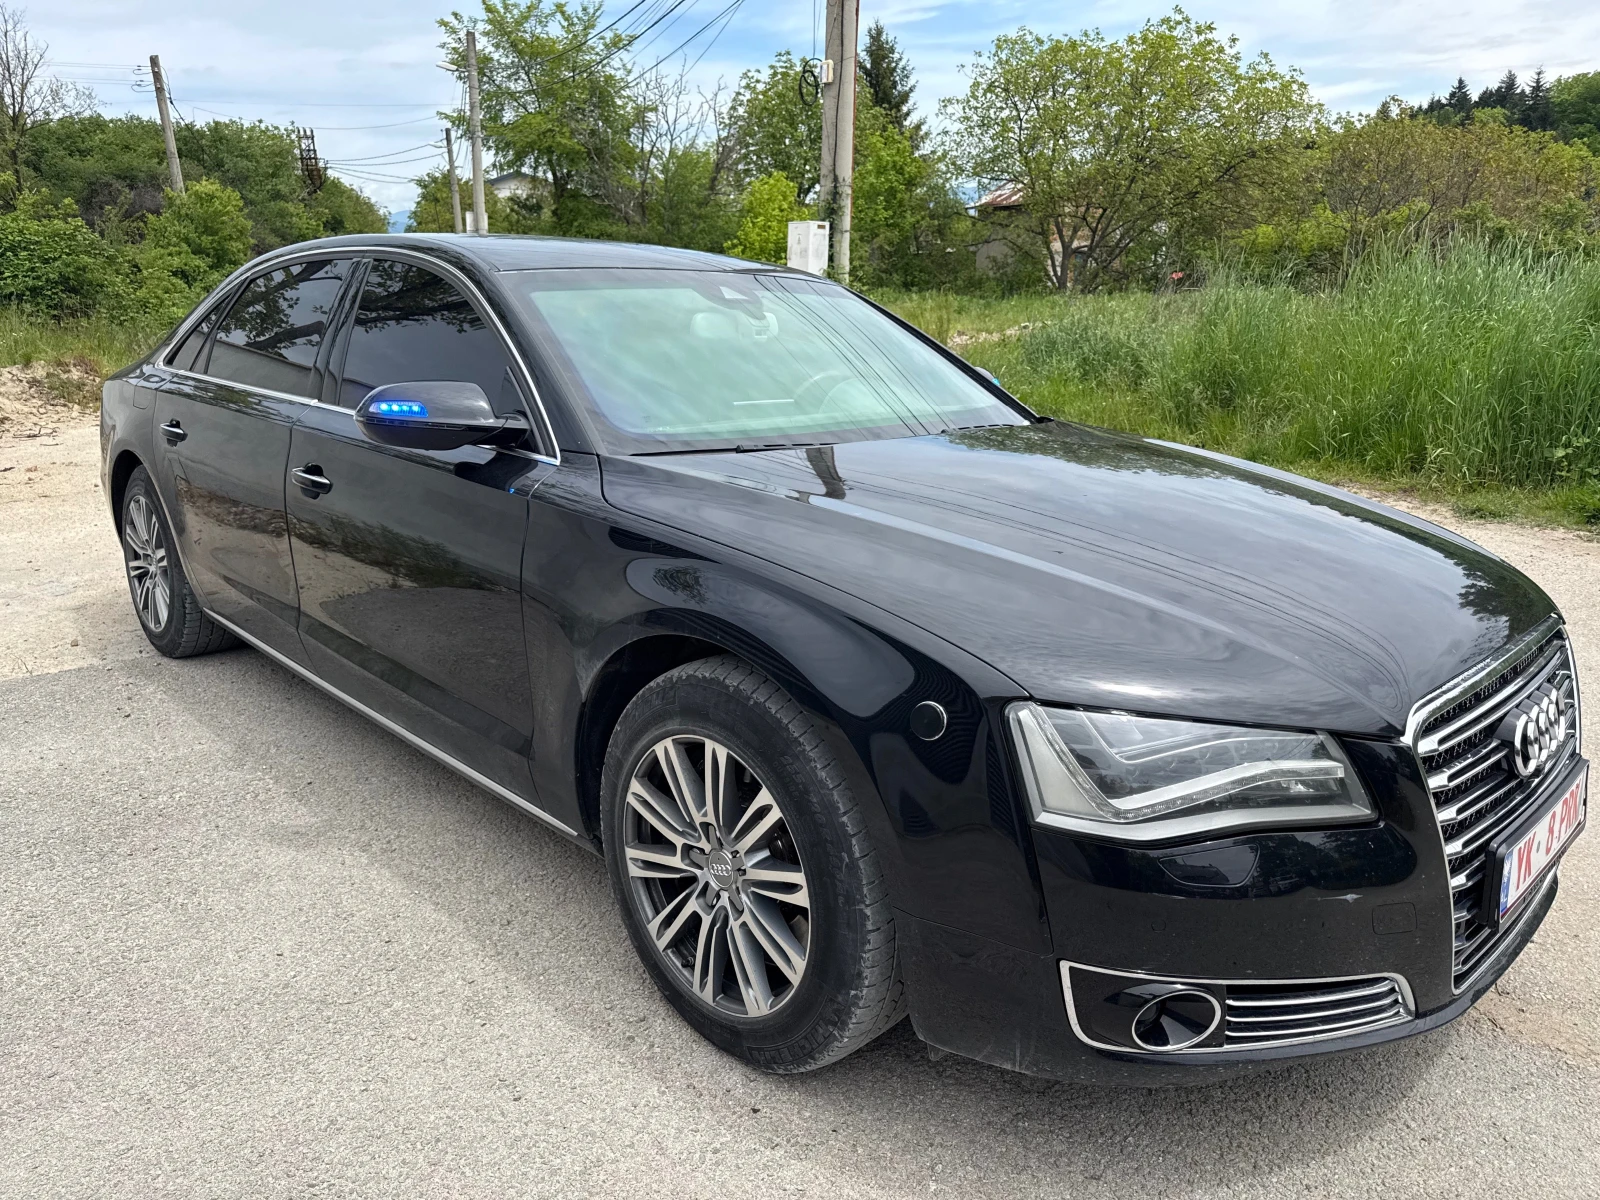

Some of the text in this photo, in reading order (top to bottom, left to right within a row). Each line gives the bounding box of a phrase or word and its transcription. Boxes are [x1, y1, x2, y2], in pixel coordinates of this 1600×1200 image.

[1516, 831, 1536, 891] YK
[1545, 810, 1556, 855] 8
[748, 1018, 831, 1066] MICHELIN
